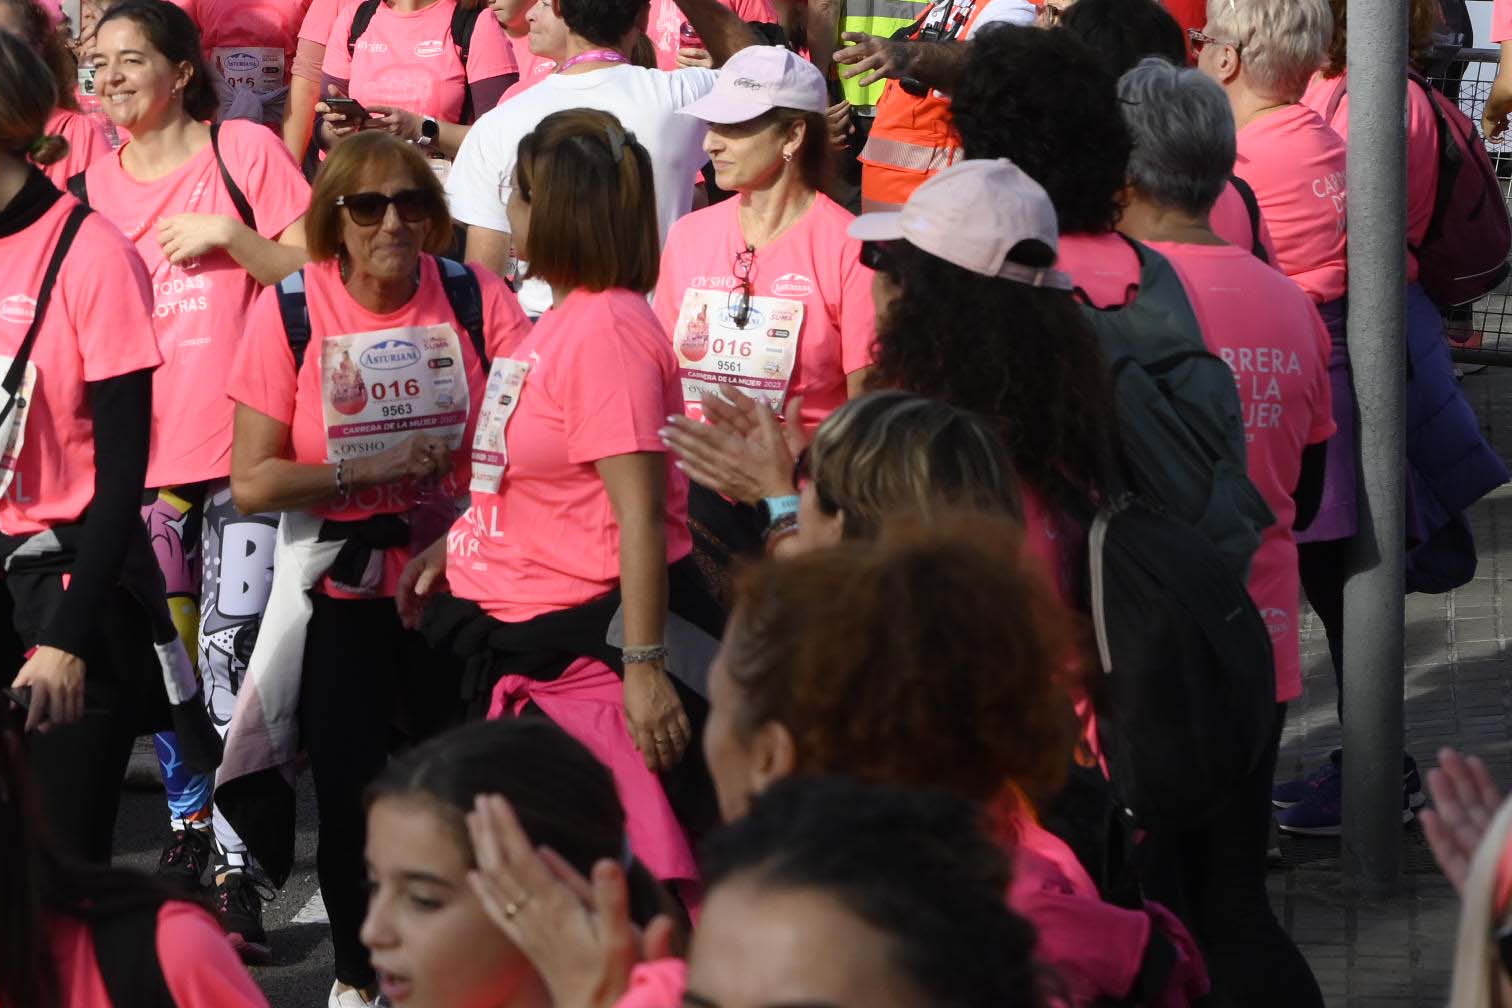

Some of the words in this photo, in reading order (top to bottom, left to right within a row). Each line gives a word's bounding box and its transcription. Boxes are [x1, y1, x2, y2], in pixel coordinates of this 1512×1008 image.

[712, 338, 753, 357] 016
[717, 360, 742, 373] 9561
[1218, 347, 1303, 376] RRERA
[371, 378, 421, 401] 016
[1251, 374, 1283, 401] LA
[381, 402, 413, 418] 9563
[1240, 400, 1283, 429] JER
[343, 424, 382, 435] CARRERA
[383, 422, 396, 432] DE
[396, 420, 408, 430] LA
[340, 440, 385, 455] OYSHO
